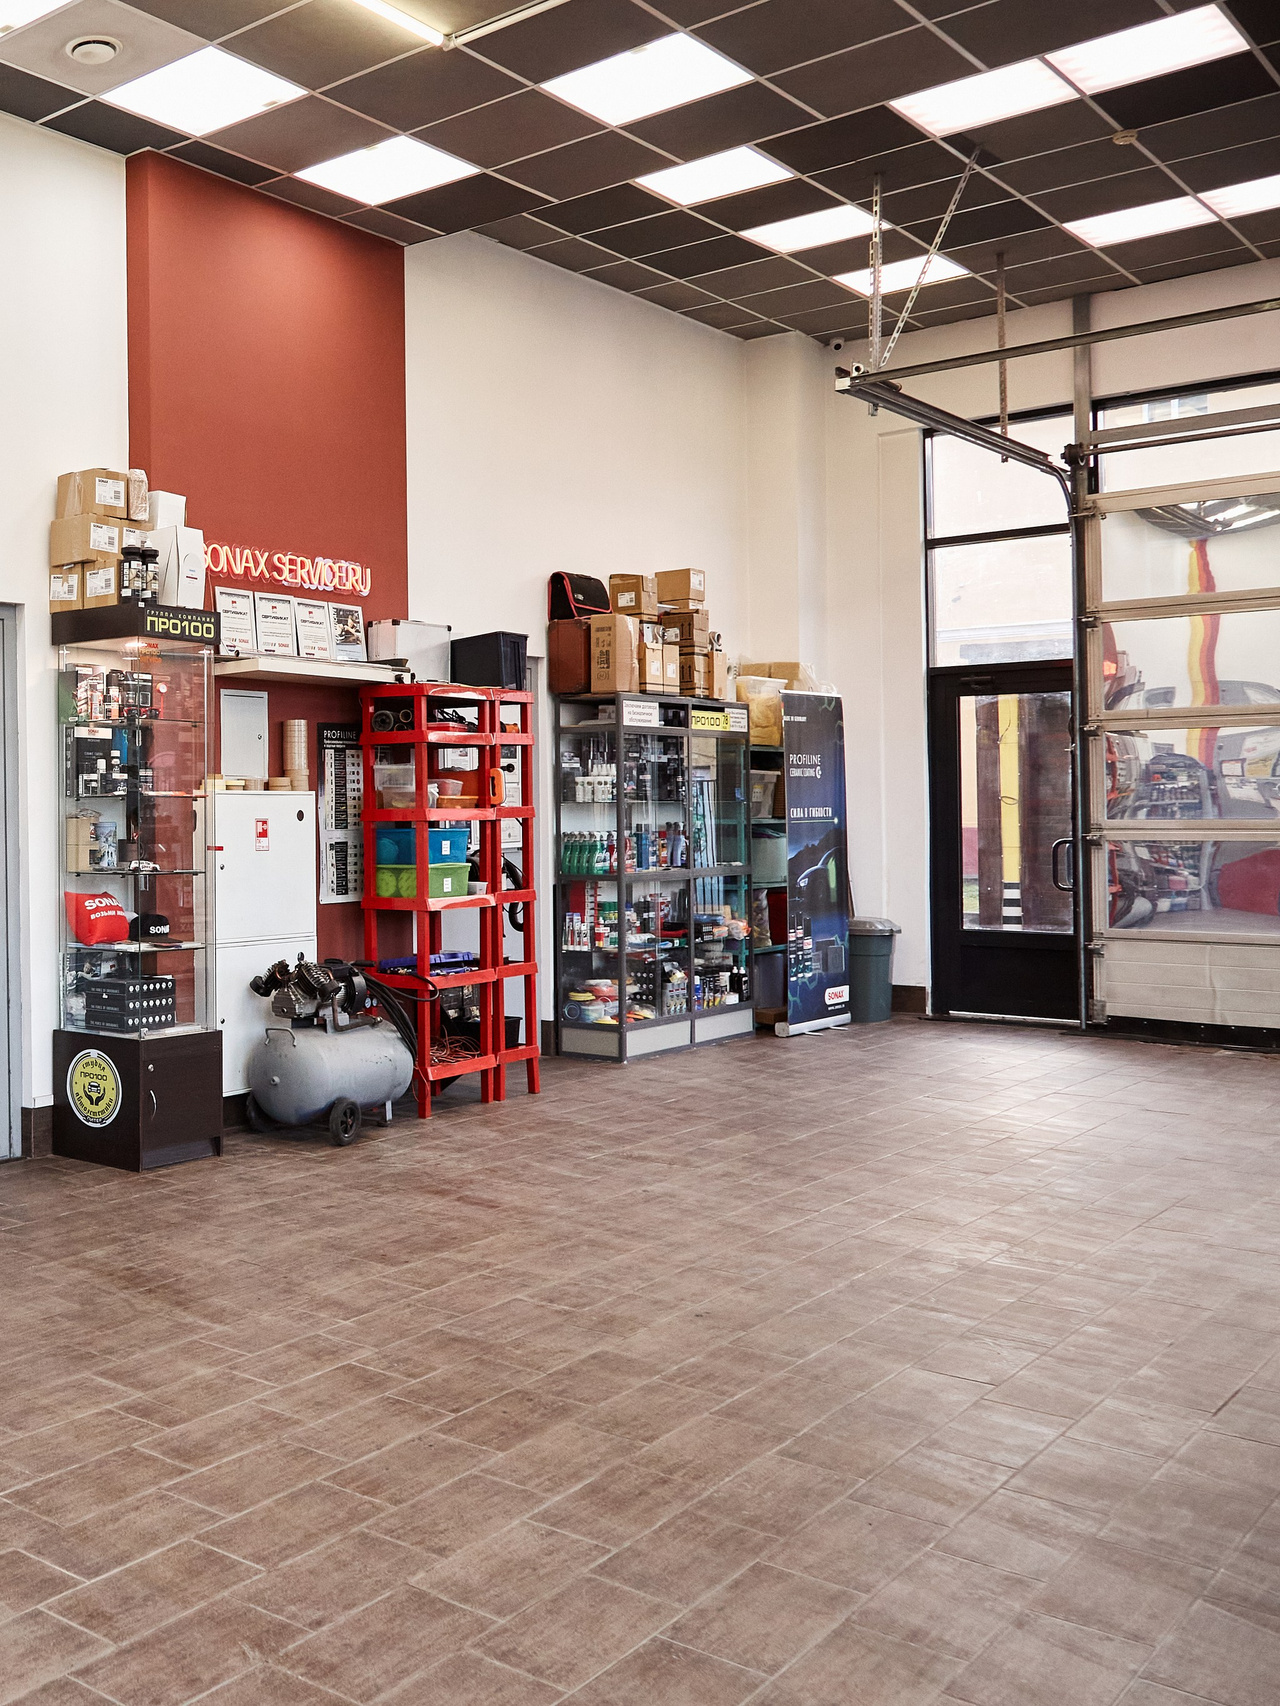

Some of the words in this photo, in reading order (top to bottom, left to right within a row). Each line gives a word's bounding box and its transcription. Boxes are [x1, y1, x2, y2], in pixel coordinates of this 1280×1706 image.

[147, 609, 173, 618] ГРУППА
[179, 614, 215, 622] КОМПАНИЙ
[146, 616, 215, 638] ПРО100
[323, 730, 357, 739] PROFILINE
[789, 754, 821, 765] PROFILINE
[790, 808, 803, 818] СИЛА
[809, 807, 832, 818] ГИБКОСТИ
[828, 990, 844, 1000] SONAX
[80, 1071, 107, 1081] ПРО100
